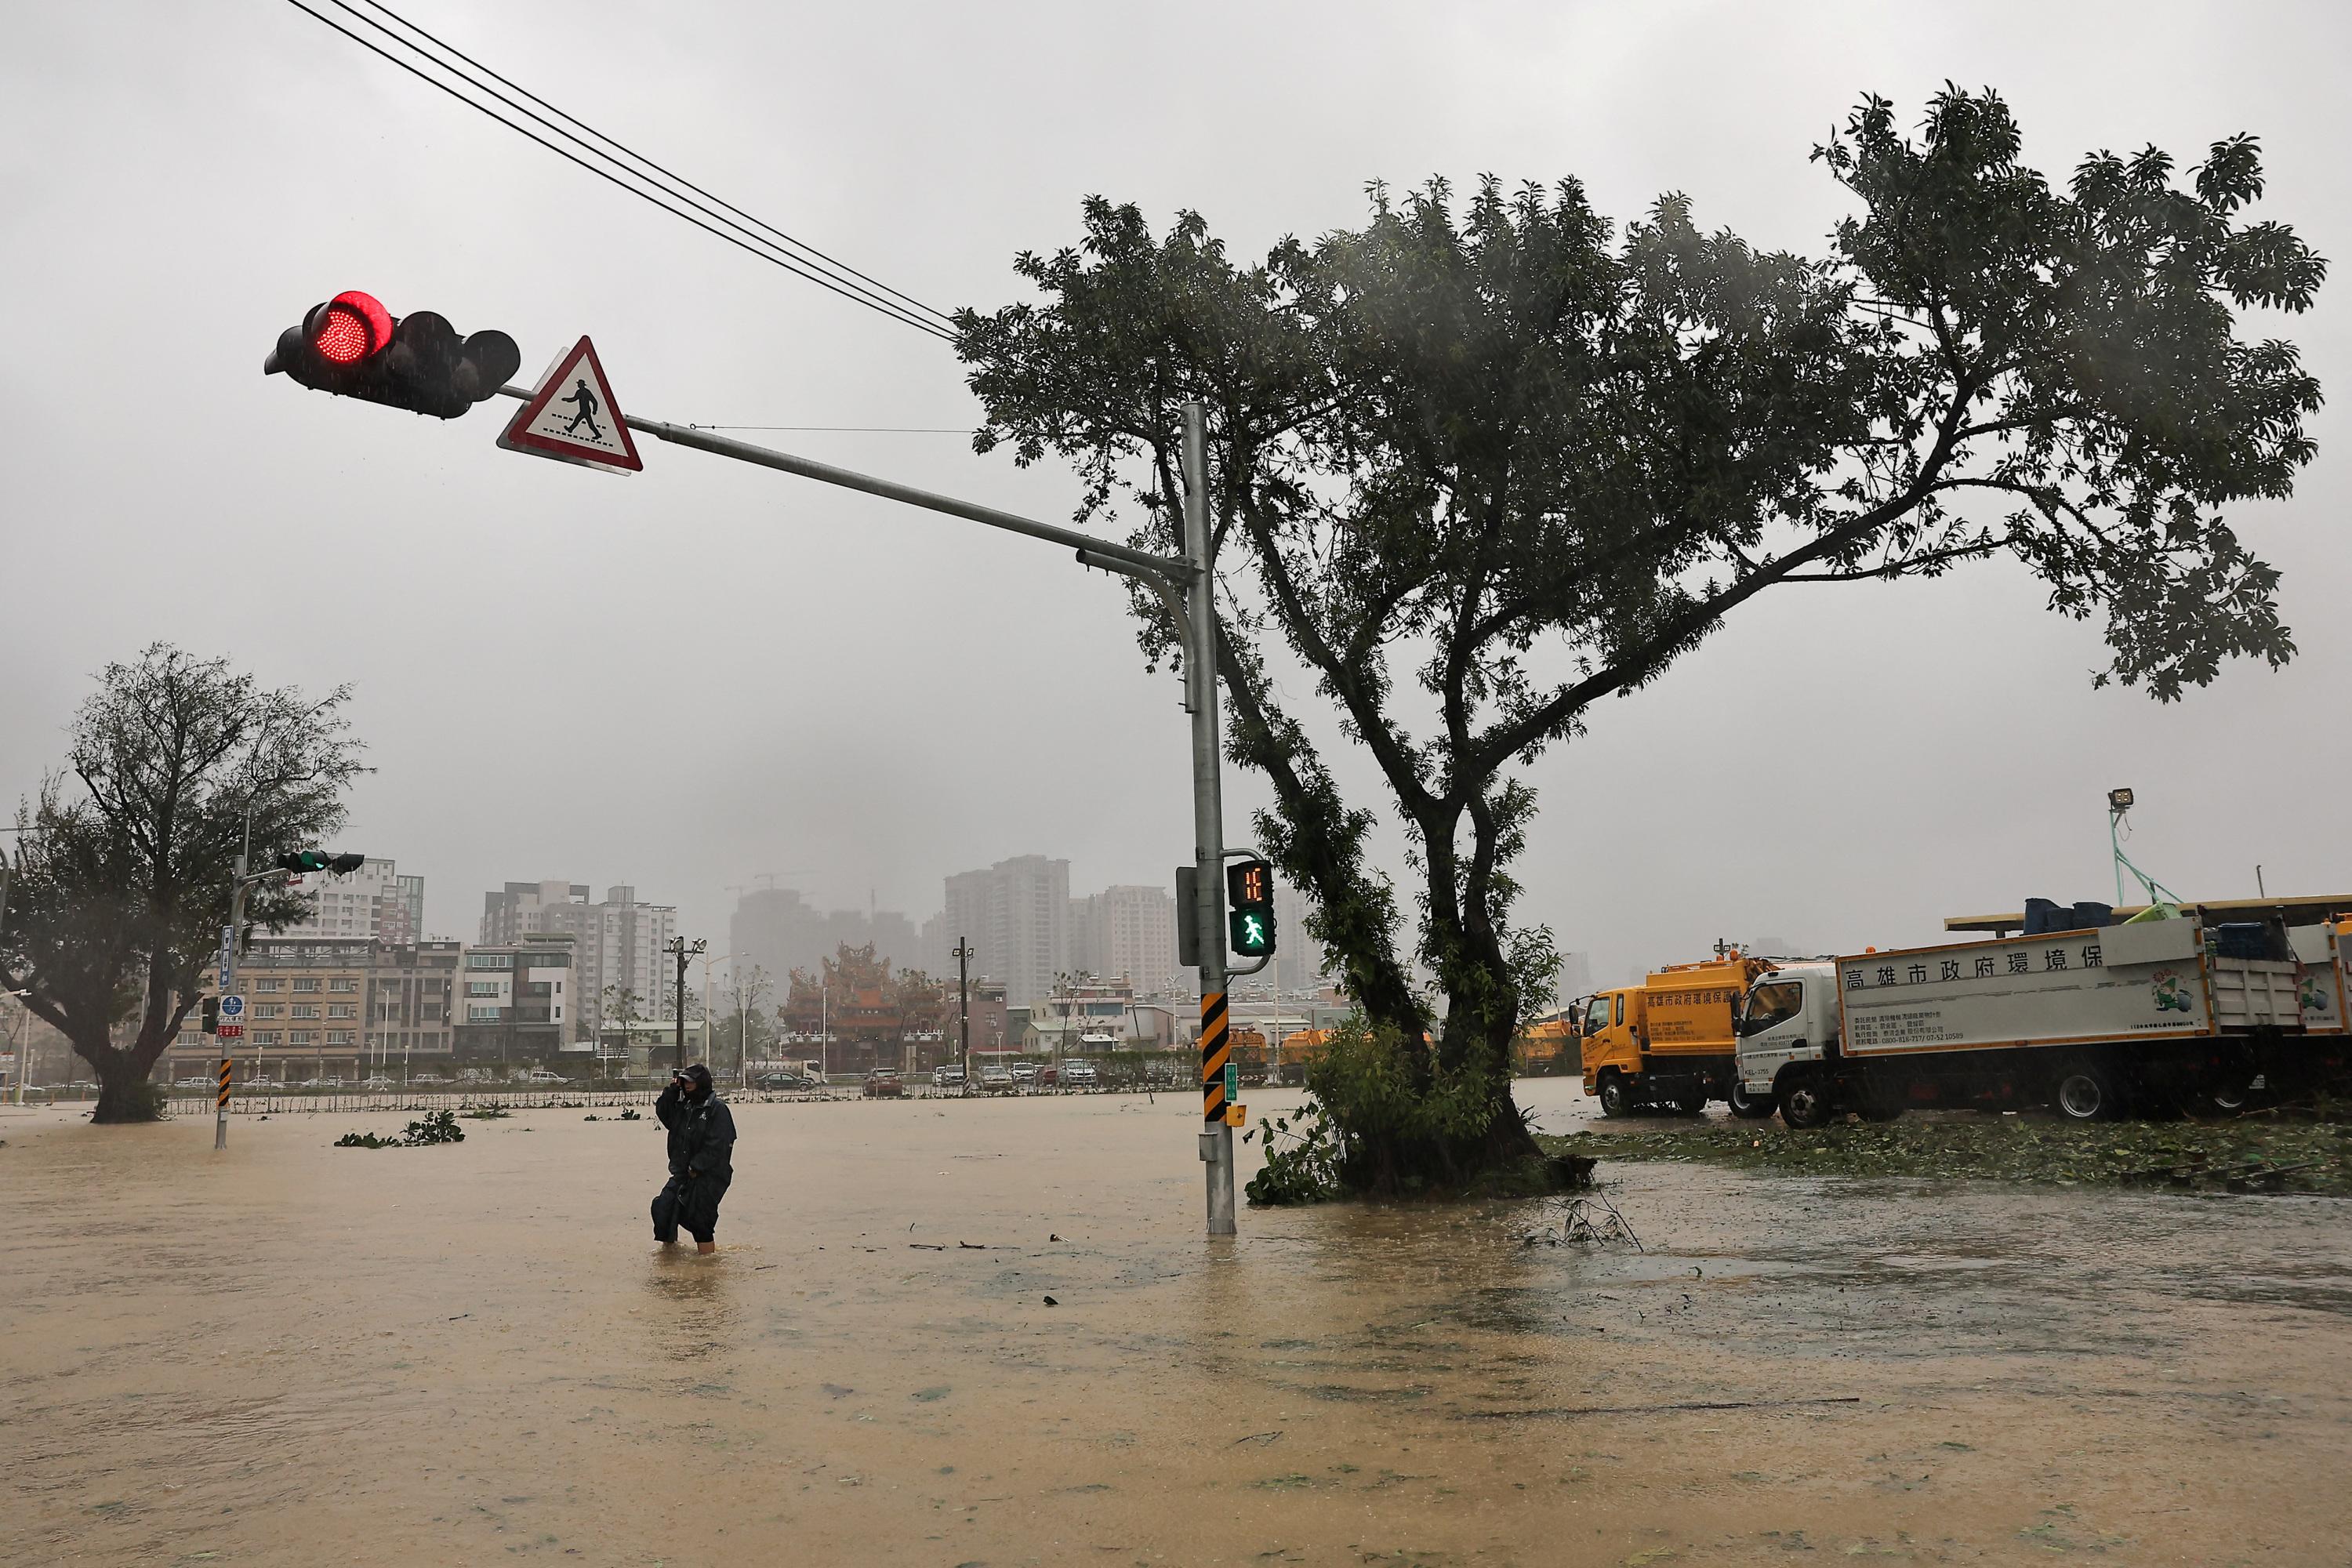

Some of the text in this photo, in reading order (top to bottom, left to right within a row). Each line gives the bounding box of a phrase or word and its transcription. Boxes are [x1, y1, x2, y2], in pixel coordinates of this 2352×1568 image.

[1647, 991, 1742, 1007] 高雄市政府環境保護
